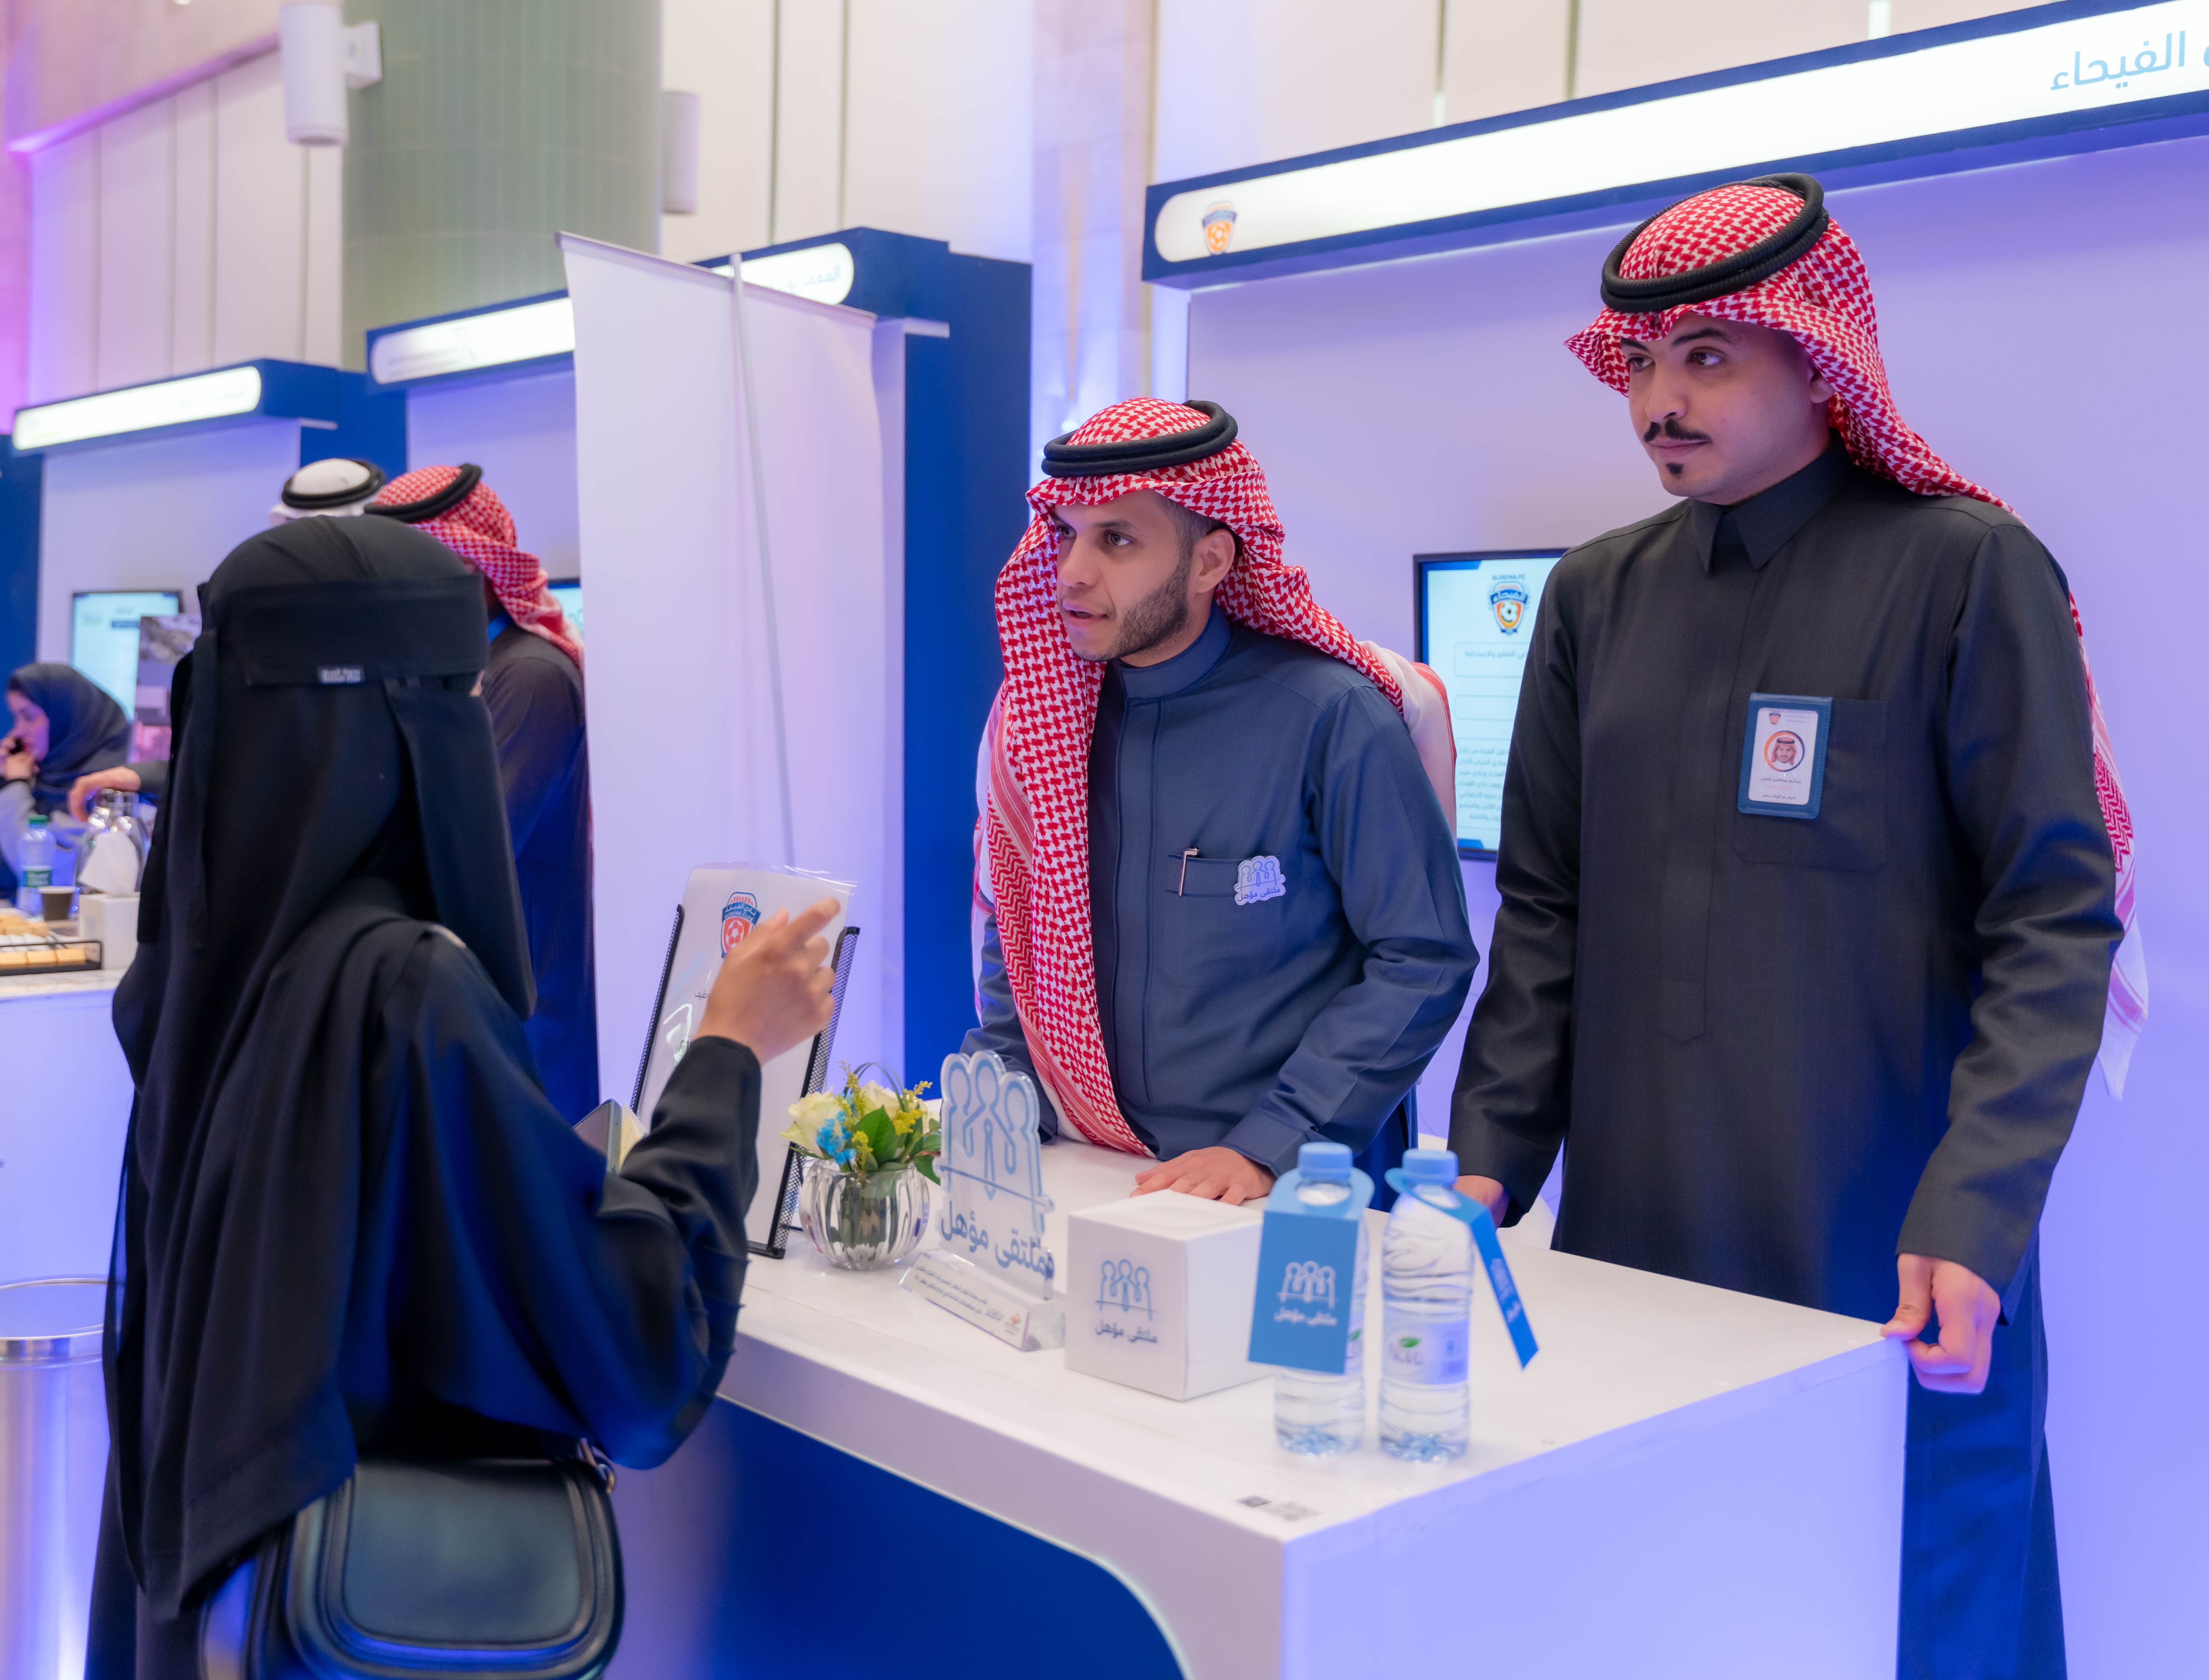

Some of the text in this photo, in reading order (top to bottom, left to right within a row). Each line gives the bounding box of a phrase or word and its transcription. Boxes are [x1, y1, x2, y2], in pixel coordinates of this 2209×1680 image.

[2051, 30, 2186, 91] الفيحاء
[1237, 887, 1281, 902] ملتقى مؤهل
[724, 911, 754, 922] ALFAYHA CLUB
[941, 1200, 1054, 1279] ملتقى مؤهل
[1273, 1307, 1338, 1328] ملتقى مؤهل
